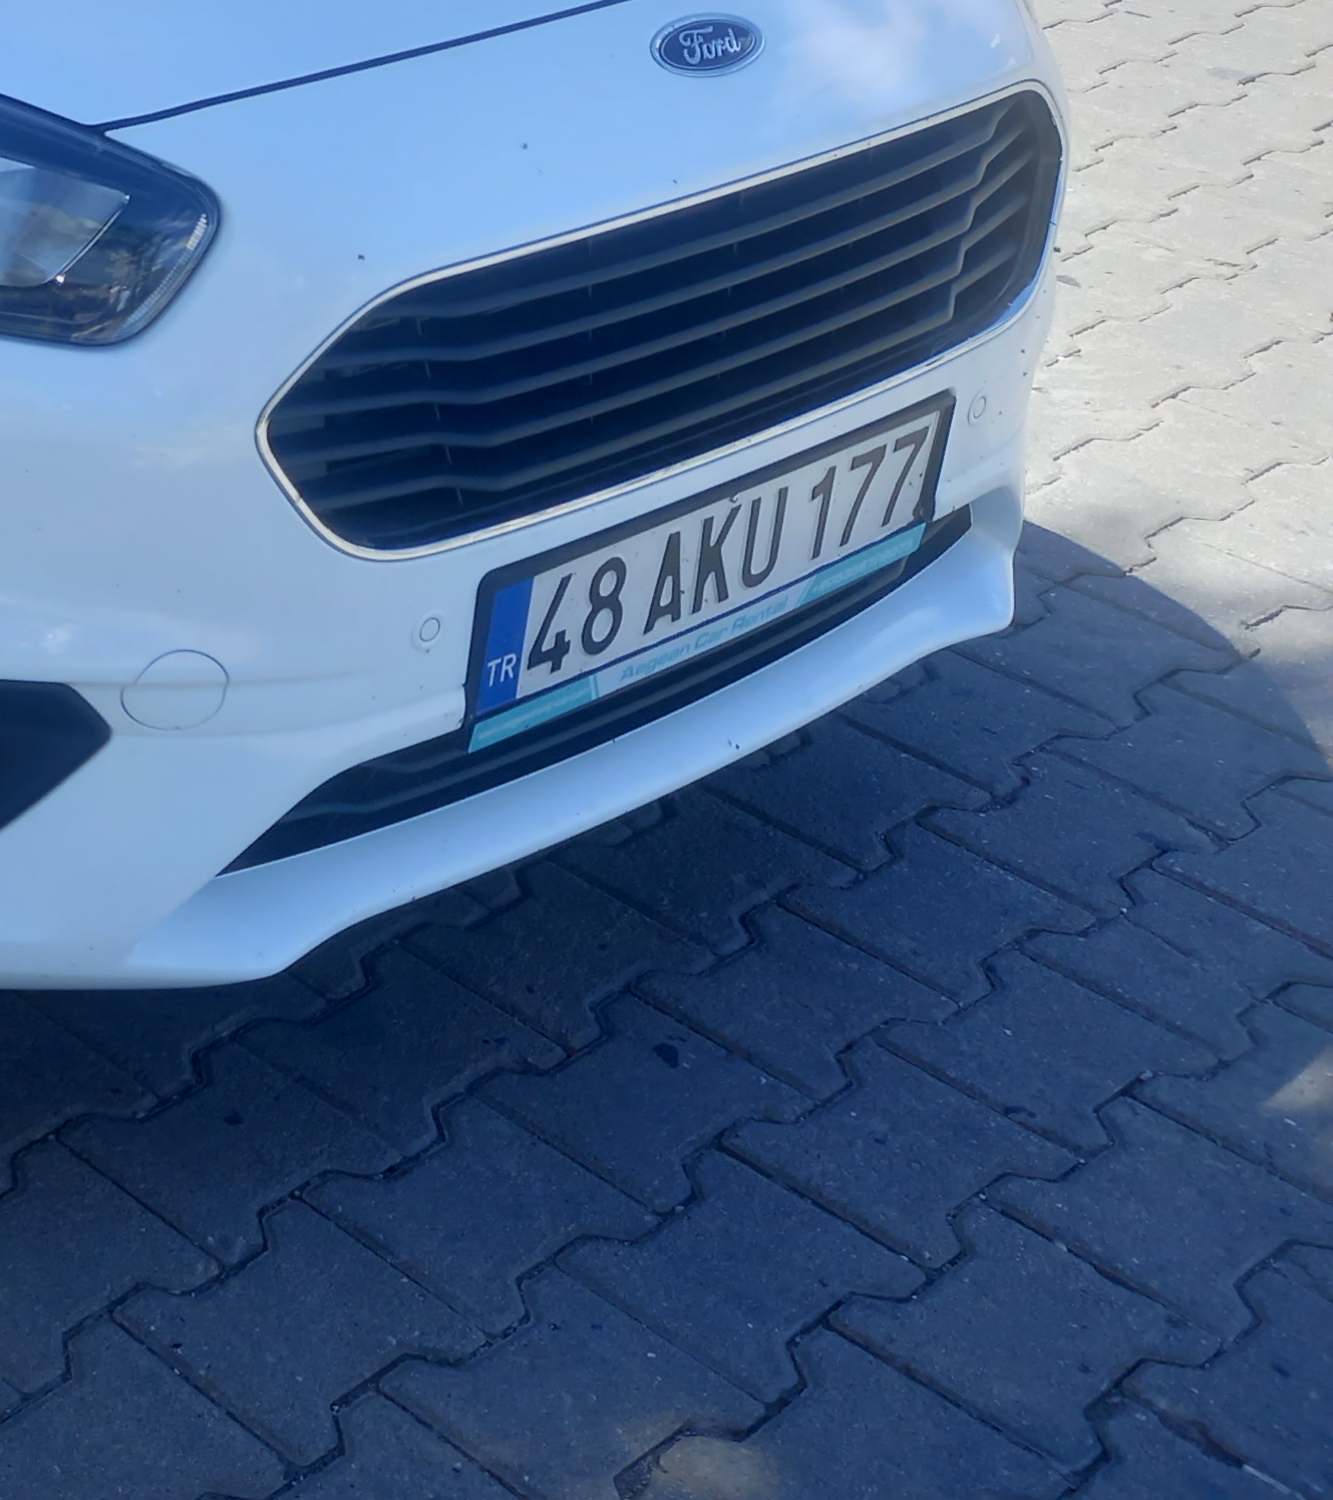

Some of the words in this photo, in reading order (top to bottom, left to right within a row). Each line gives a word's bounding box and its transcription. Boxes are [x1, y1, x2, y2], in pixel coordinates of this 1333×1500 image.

[678, 24, 742, 65] Ford
[526, 556, 627, 674] 48
[644, 487, 789, 636] AKU
[809, 426, 931, 562] 177
[486, 652, 518, 688] TR
[619, 642, 691, 682] Aegean
[694, 626, 728, 650] Car
[730, 596, 789, 634] Rental
